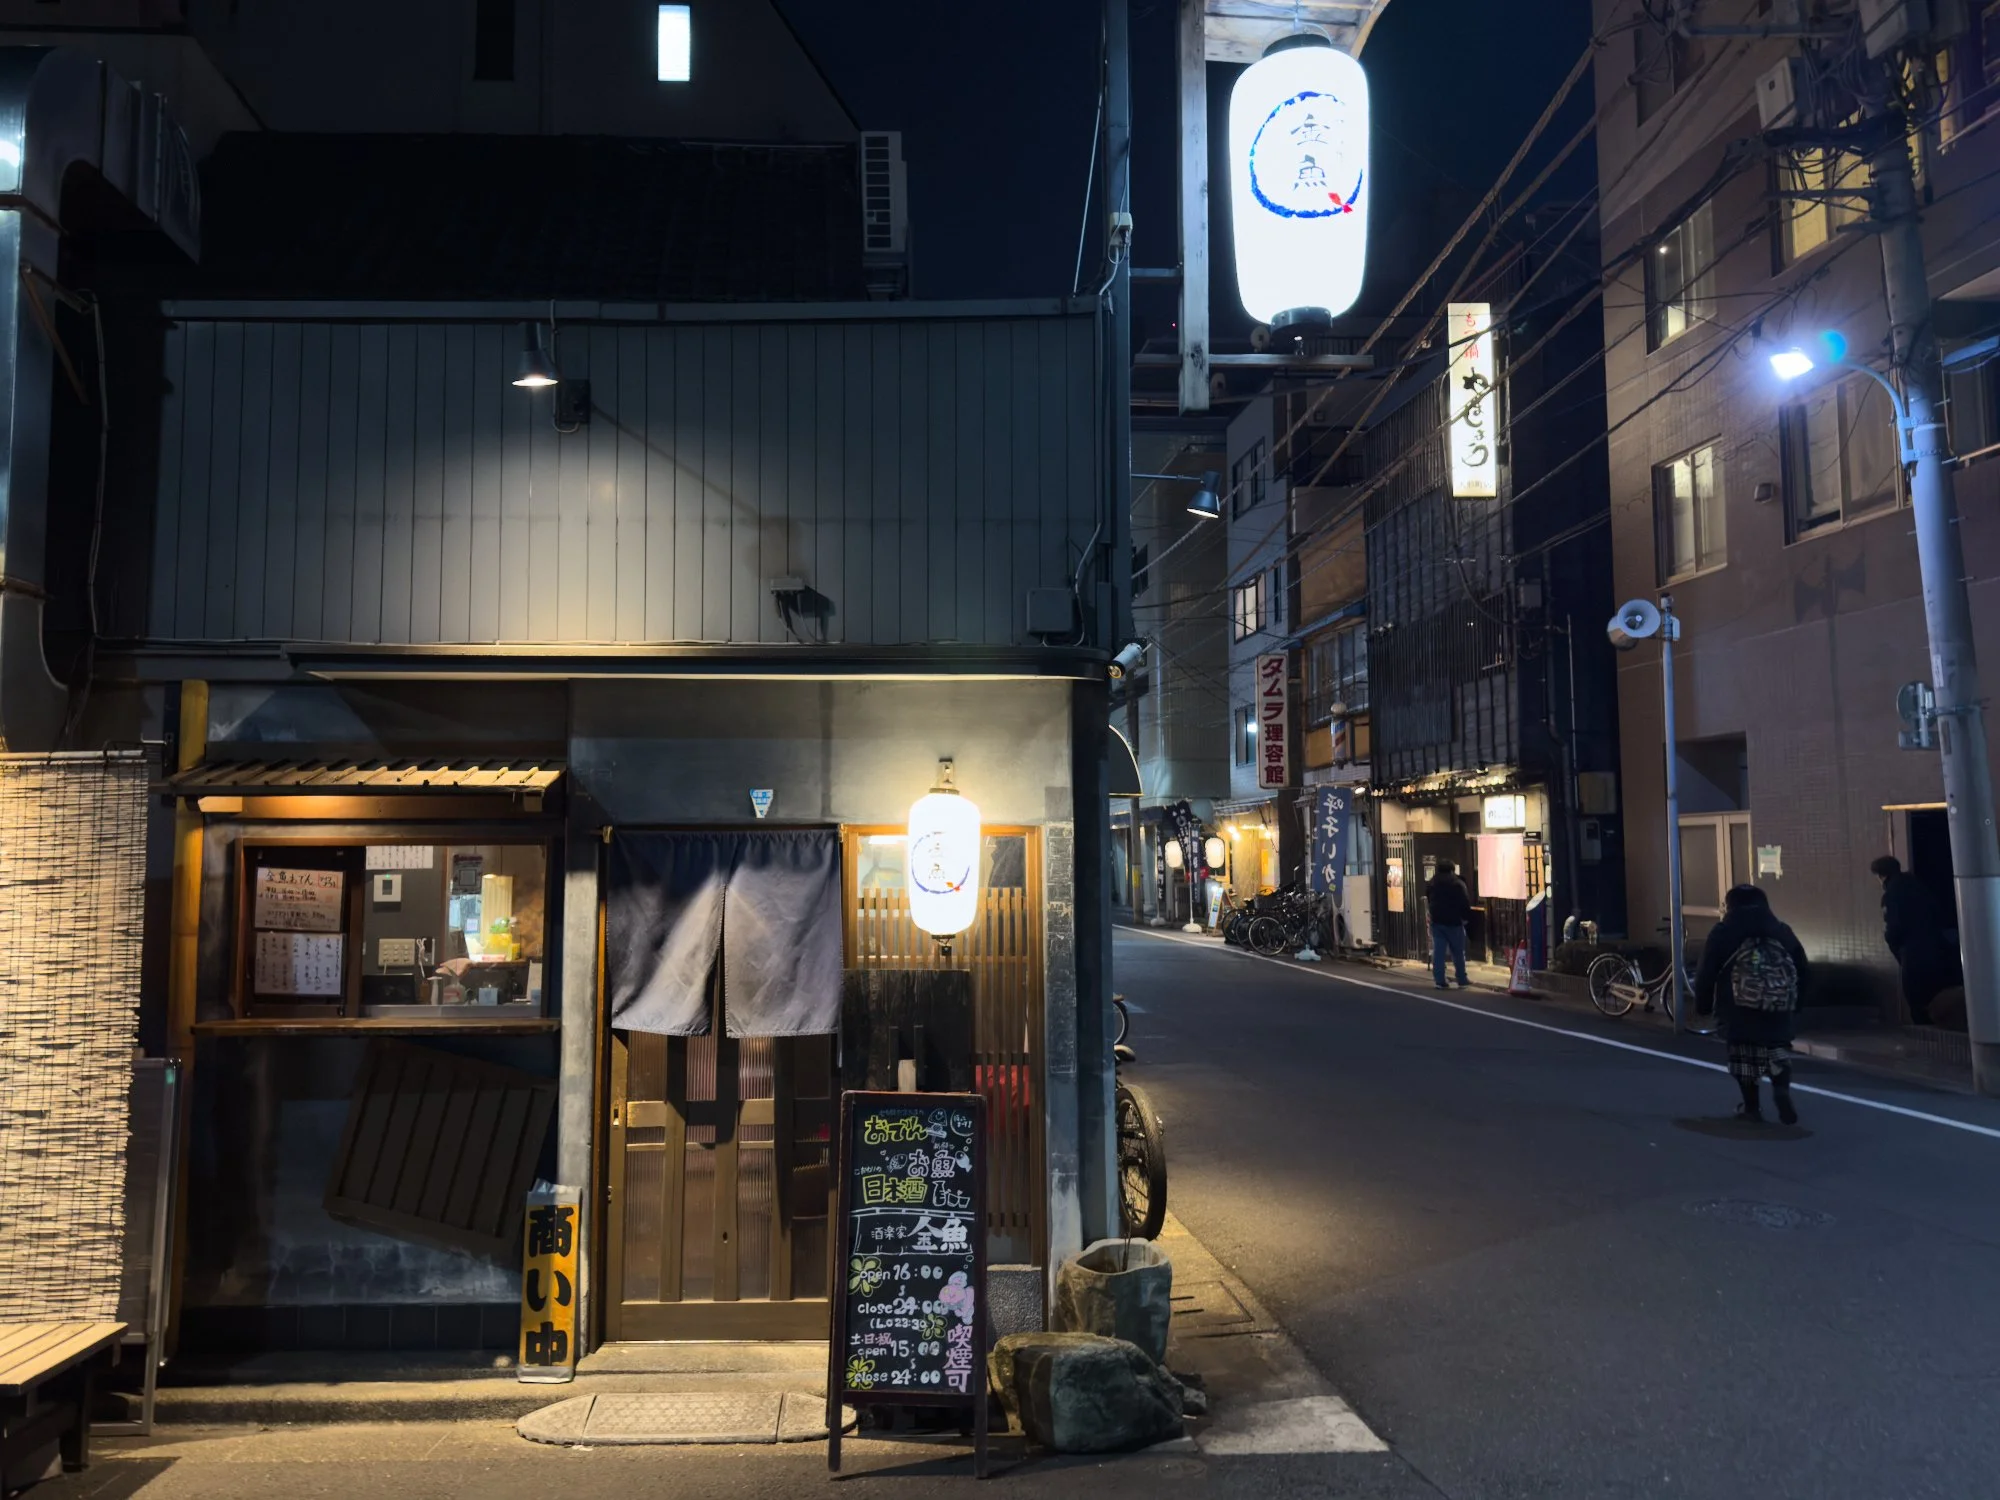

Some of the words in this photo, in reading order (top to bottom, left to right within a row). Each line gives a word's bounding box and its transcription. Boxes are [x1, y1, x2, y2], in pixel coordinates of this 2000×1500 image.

[1291, 113, 1330, 190] 金魚
[1262, 657, 1285, 784] タムラ理容館
[864, 1115, 928, 1145] おでん
[908, 1148, 956, 1178] お魚
[862, 1174, 928, 1204] 日本酒
[871, 1225, 908, 1240] 酒楽家
[908, 1216, 968, 1251] 金魚
[525, 1204, 574, 1366] 商い中
[859, 1270, 891, 1282] open
[857, 1302, 893, 1314] close
[857, 1347, 887, 1358] open
[942, 1323, 973, 1393] 喫煙可
